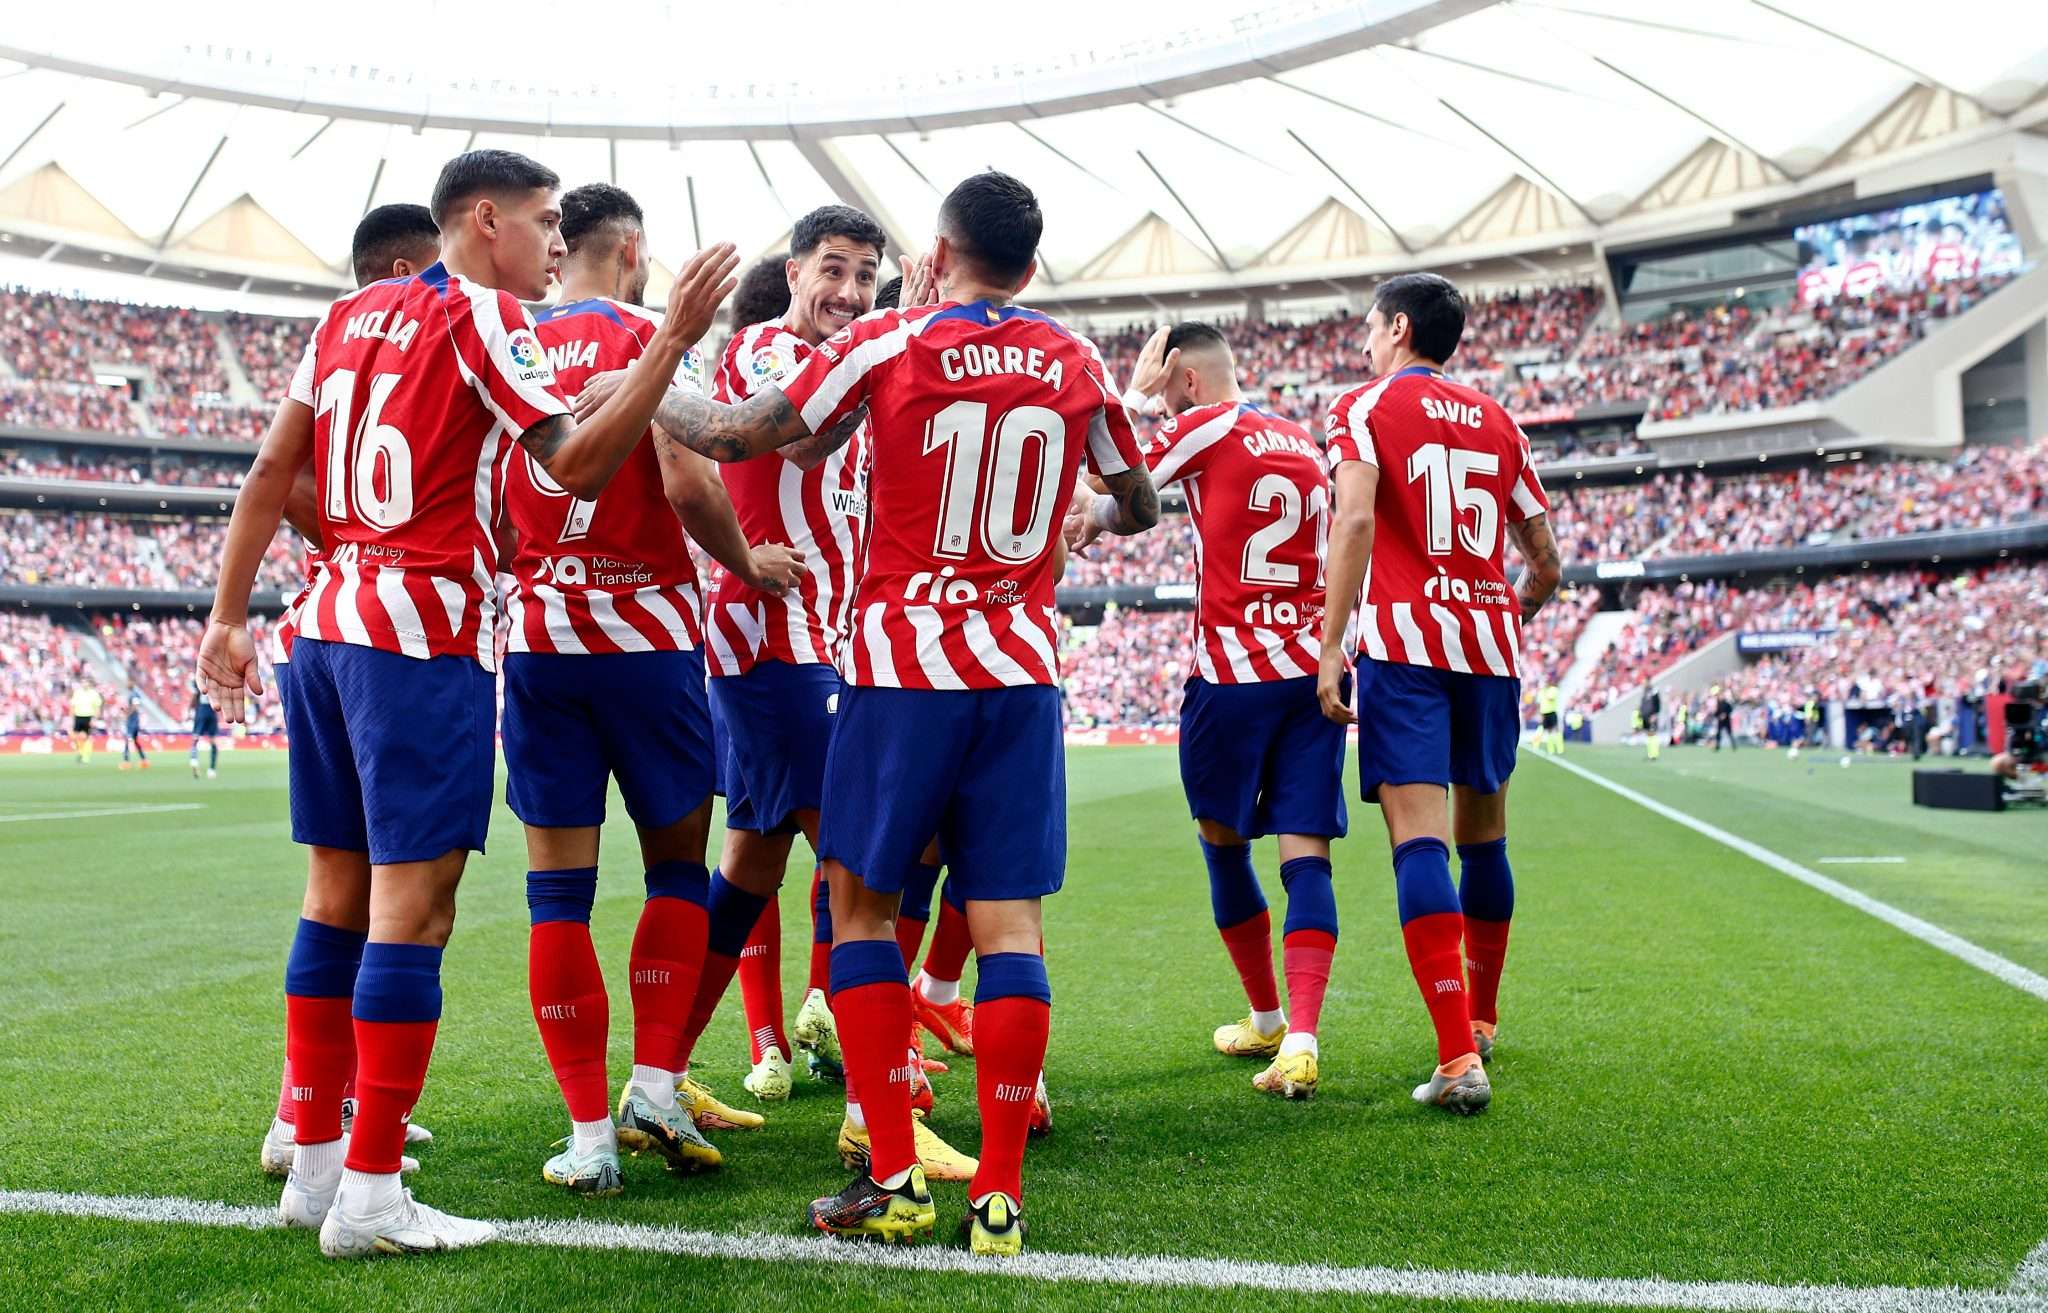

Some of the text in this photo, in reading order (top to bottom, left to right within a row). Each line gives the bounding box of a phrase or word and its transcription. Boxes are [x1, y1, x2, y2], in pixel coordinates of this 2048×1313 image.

[519, 369, 549, 381] LaLiga
[940, 344, 1063, 391] CORREA
[1421, 397, 1483, 429] SAVIĆ
[315, 368, 413, 532] 16
[922, 400, 1066, 565] 10
[1407, 443, 1499, 561] 15
[1240, 473, 1328, 590] 21
[363, 543, 405, 559] Money
[592, 571, 653, 586] Transfer
[903, 566, 979, 604] ria
[1424, 565, 1470, 603] ria
[1244, 592, 1298, 624] ria
